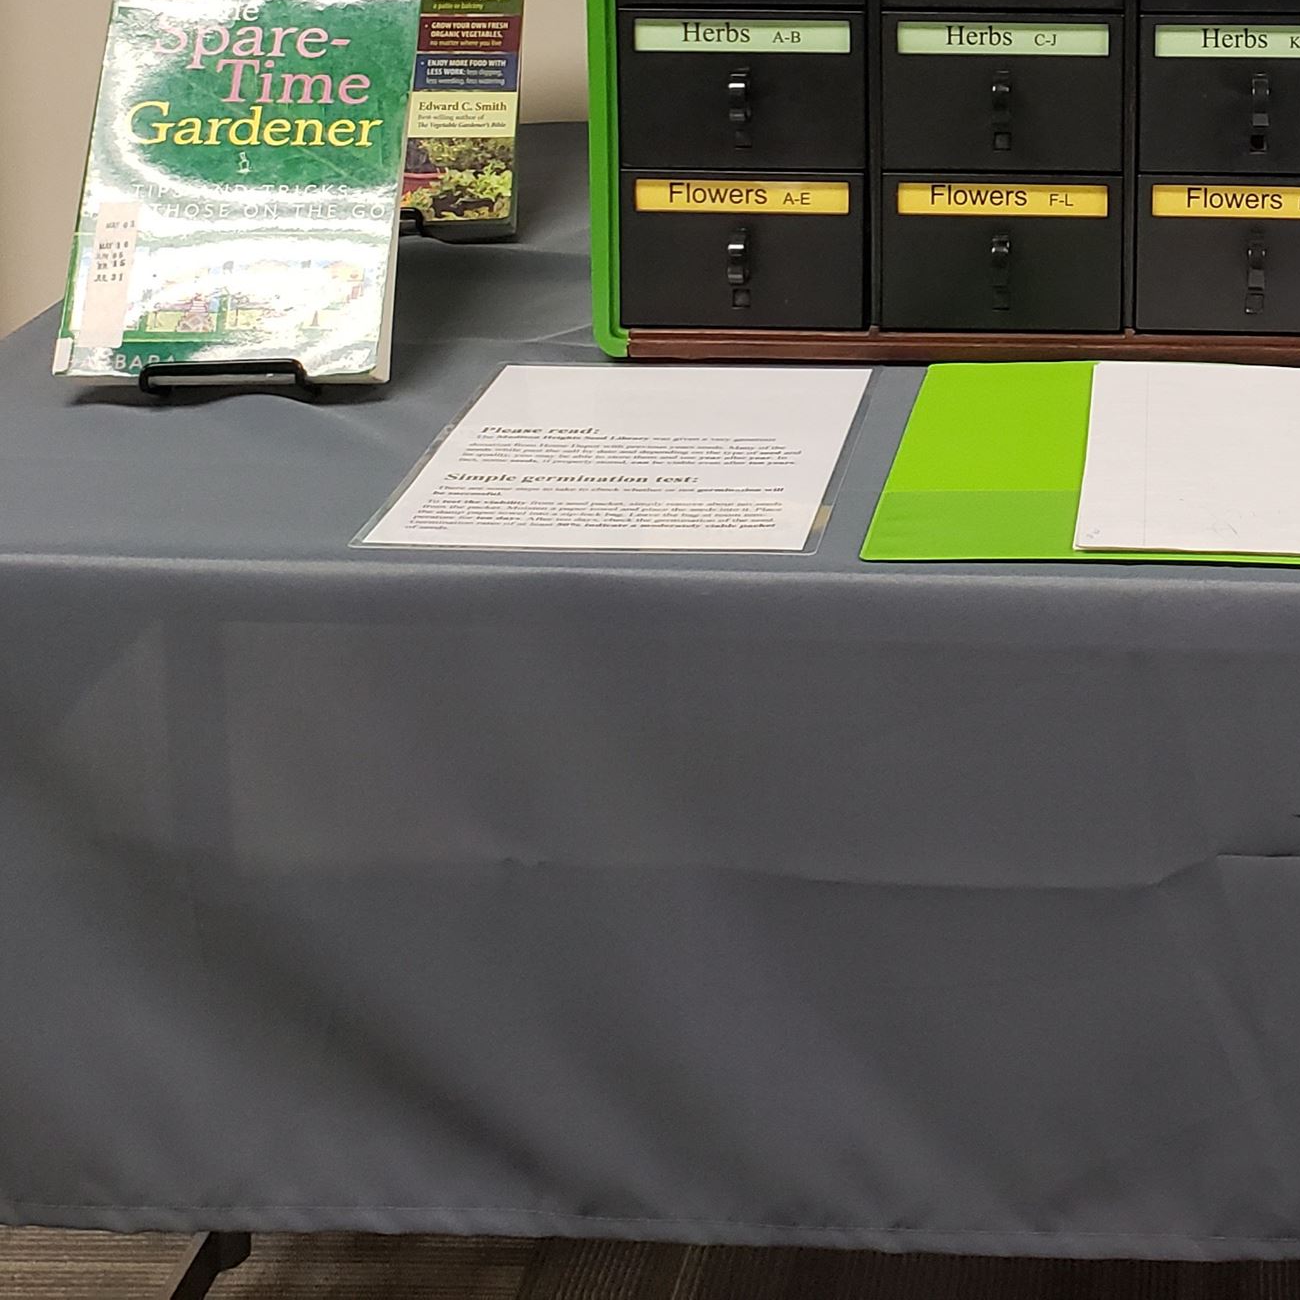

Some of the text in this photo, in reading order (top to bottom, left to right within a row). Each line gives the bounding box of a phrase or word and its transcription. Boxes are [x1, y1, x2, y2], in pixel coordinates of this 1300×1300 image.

[682, 22, 801, 44] Herbs A-B
[946, 26, 1057, 48] Herbs C-J
[1201, 28, 1268, 50] Herbs
[427, 59, 448, 67] ENJOY
[217, 58, 370, 104] Time
[418, 101, 507, 111] Edward C. Smith
[126, 100, 384, 148] Gardener
[262, 185, 350, 199] TRICKS
[669, 182, 811, 206] Flowers A-E
[930, 185, 1074, 207] Flowers F-L
[1187, 188, 1283, 211] Flowers
[149, 204, 386, 219] THOSE ON THE GO
[444, 474, 517, 483] Simple
[521, 475, 648, 483] germination
